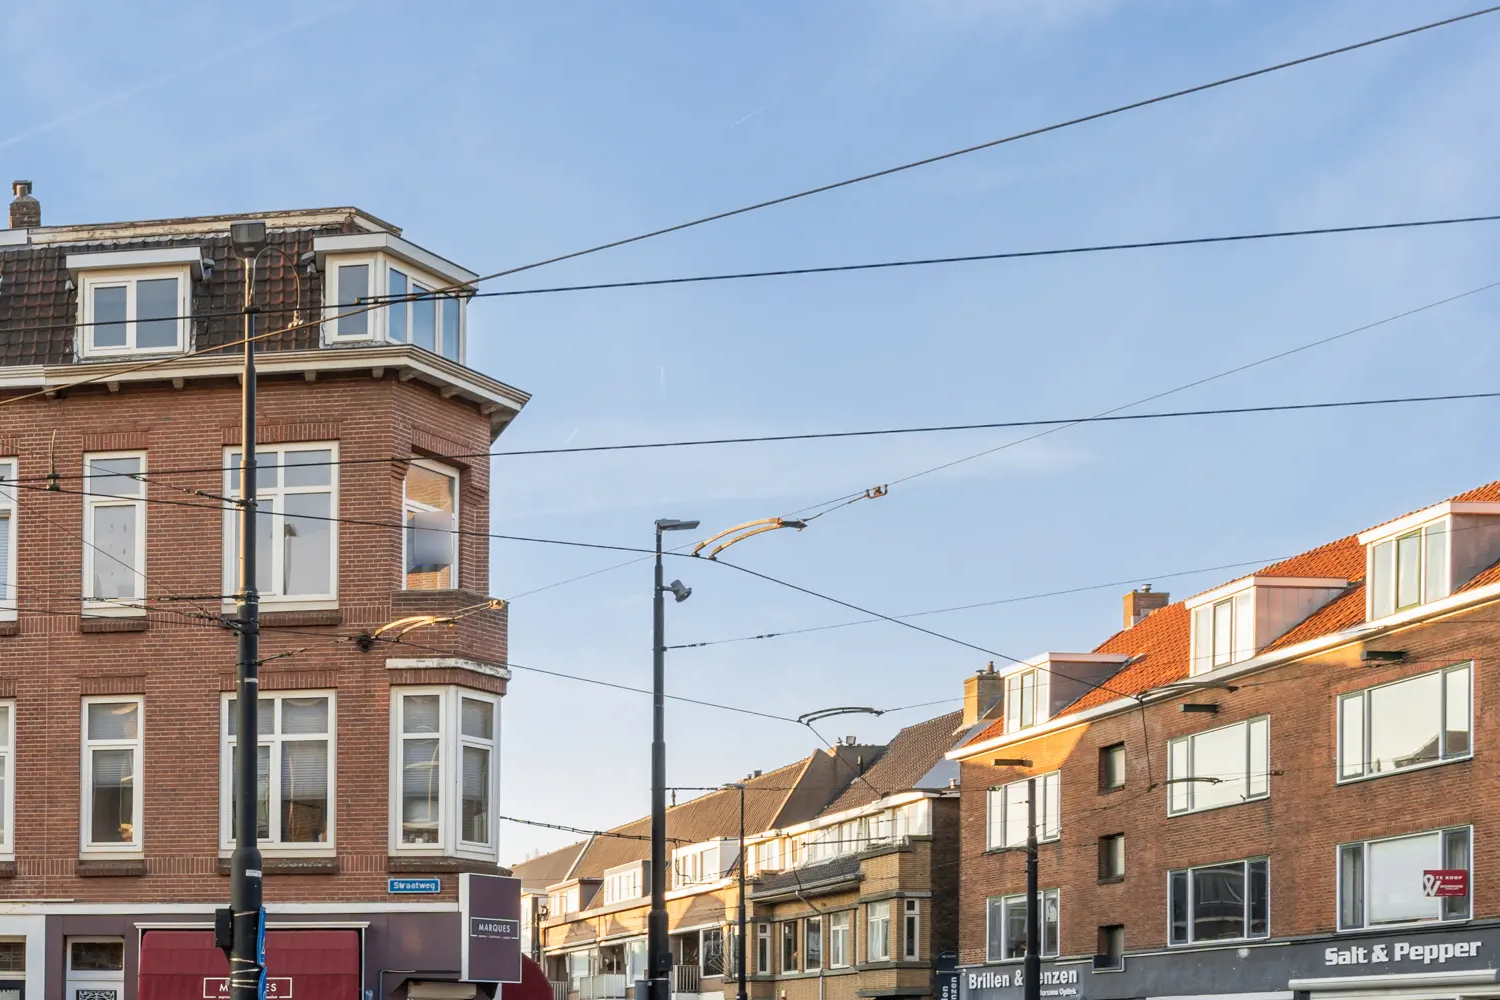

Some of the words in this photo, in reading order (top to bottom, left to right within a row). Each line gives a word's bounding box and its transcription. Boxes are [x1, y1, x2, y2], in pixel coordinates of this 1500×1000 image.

[393, 881, 436, 891] Straatweg
[478, 923, 511, 933] MARQUES
[1325, 946, 1368, 966] Salt
[1371, 944, 1389, 963] &
[1394, 941, 1482, 964] Pepper
[968, 972, 1010, 990] Brillen
[1014, 969, 1024, 986] &
[1040, 970, 1078, 984] enzen
